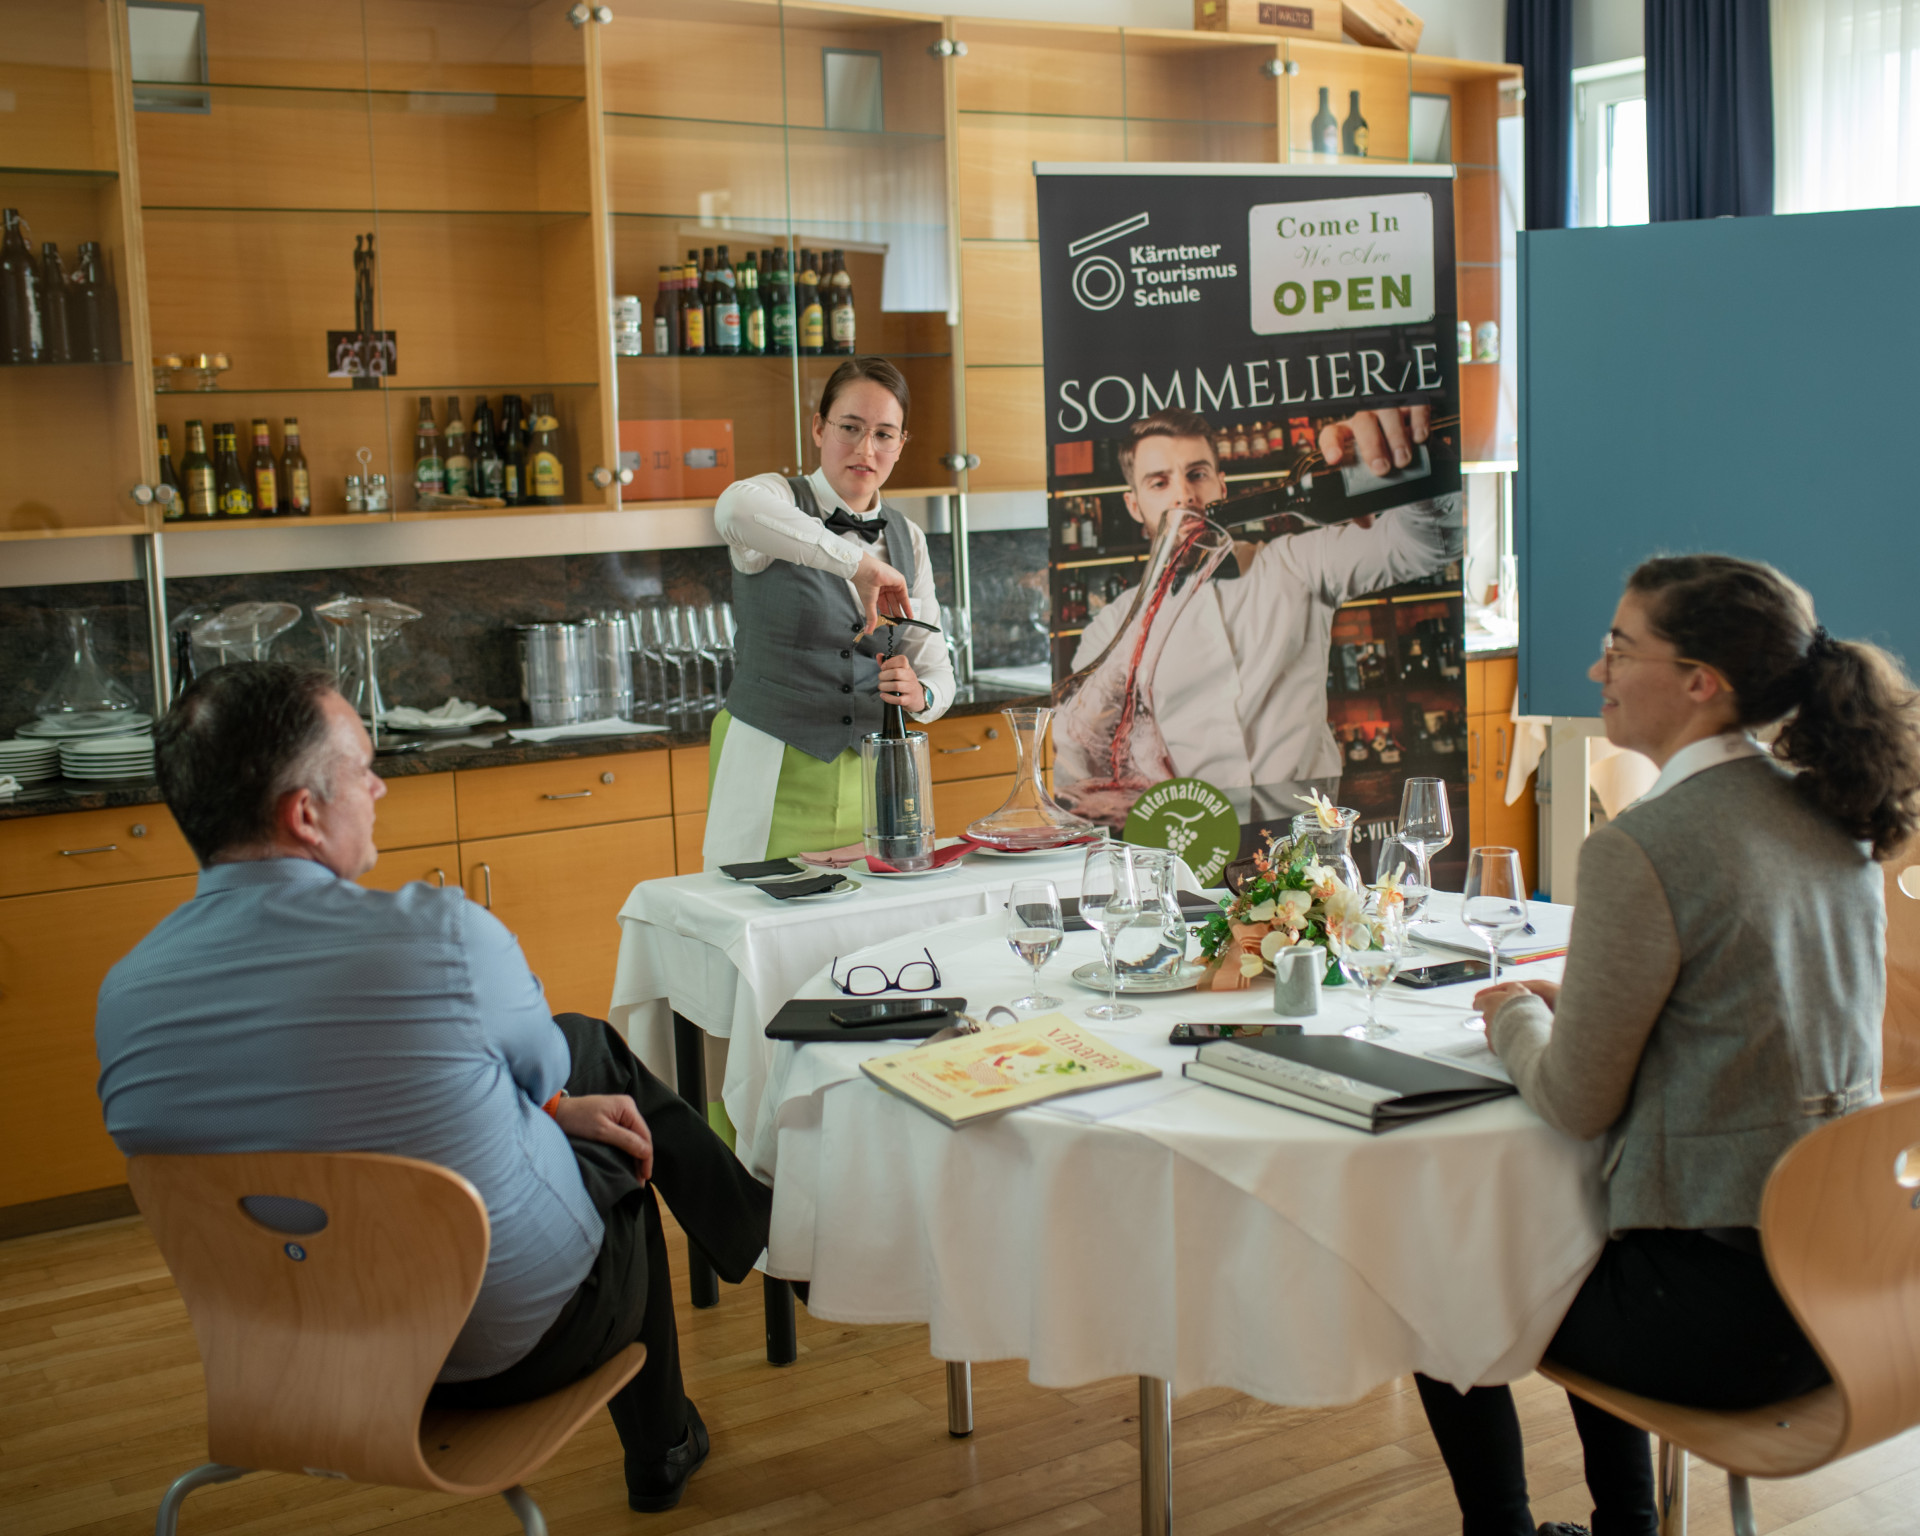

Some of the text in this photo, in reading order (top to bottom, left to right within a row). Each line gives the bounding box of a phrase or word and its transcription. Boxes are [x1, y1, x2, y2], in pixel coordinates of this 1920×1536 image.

[1277, 211, 1400, 239] Come In
[1129, 243, 1221, 265] Kärntner
[1294, 241, 1391, 269] We Are
[1131, 263, 1238, 286] Tourismus
[1133, 285, 1201, 307] Schule
[1273, 274, 1412, 316] OPEN
[1057, 343, 1443, 433] SOMMELIER/E
[1132, 781, 1230, 821] International
[1195, 846, 1231, 886] chnet
